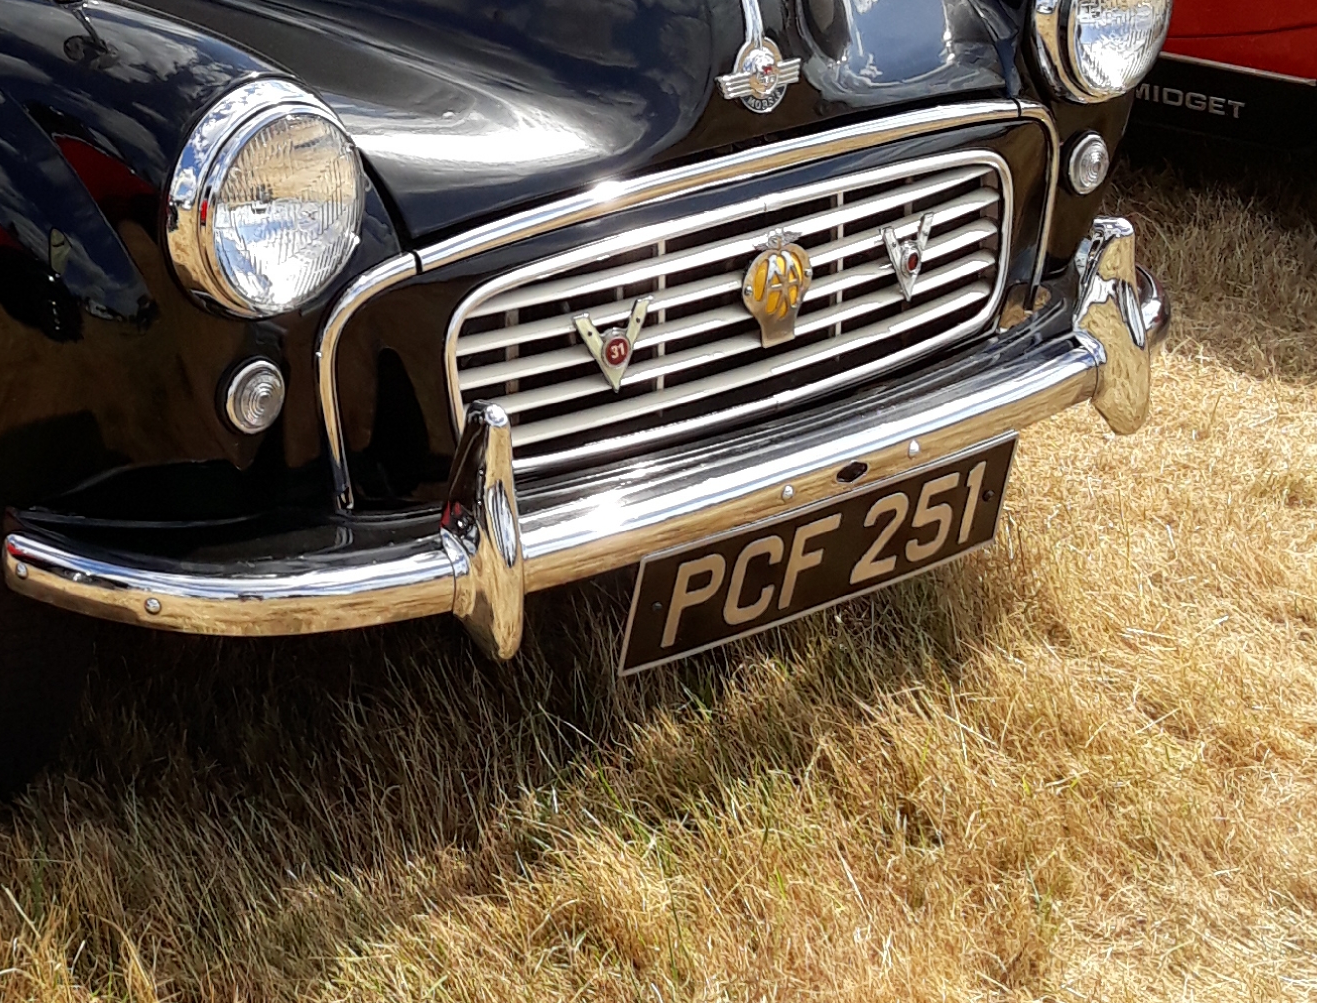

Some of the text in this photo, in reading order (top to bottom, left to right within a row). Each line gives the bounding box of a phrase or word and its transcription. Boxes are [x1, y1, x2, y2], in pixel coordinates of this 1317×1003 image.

[1135, 83, 1246, 119] MIDGET
[610, 342, 626, 360] 31
[659, 460, 988, 649] PCF 251
